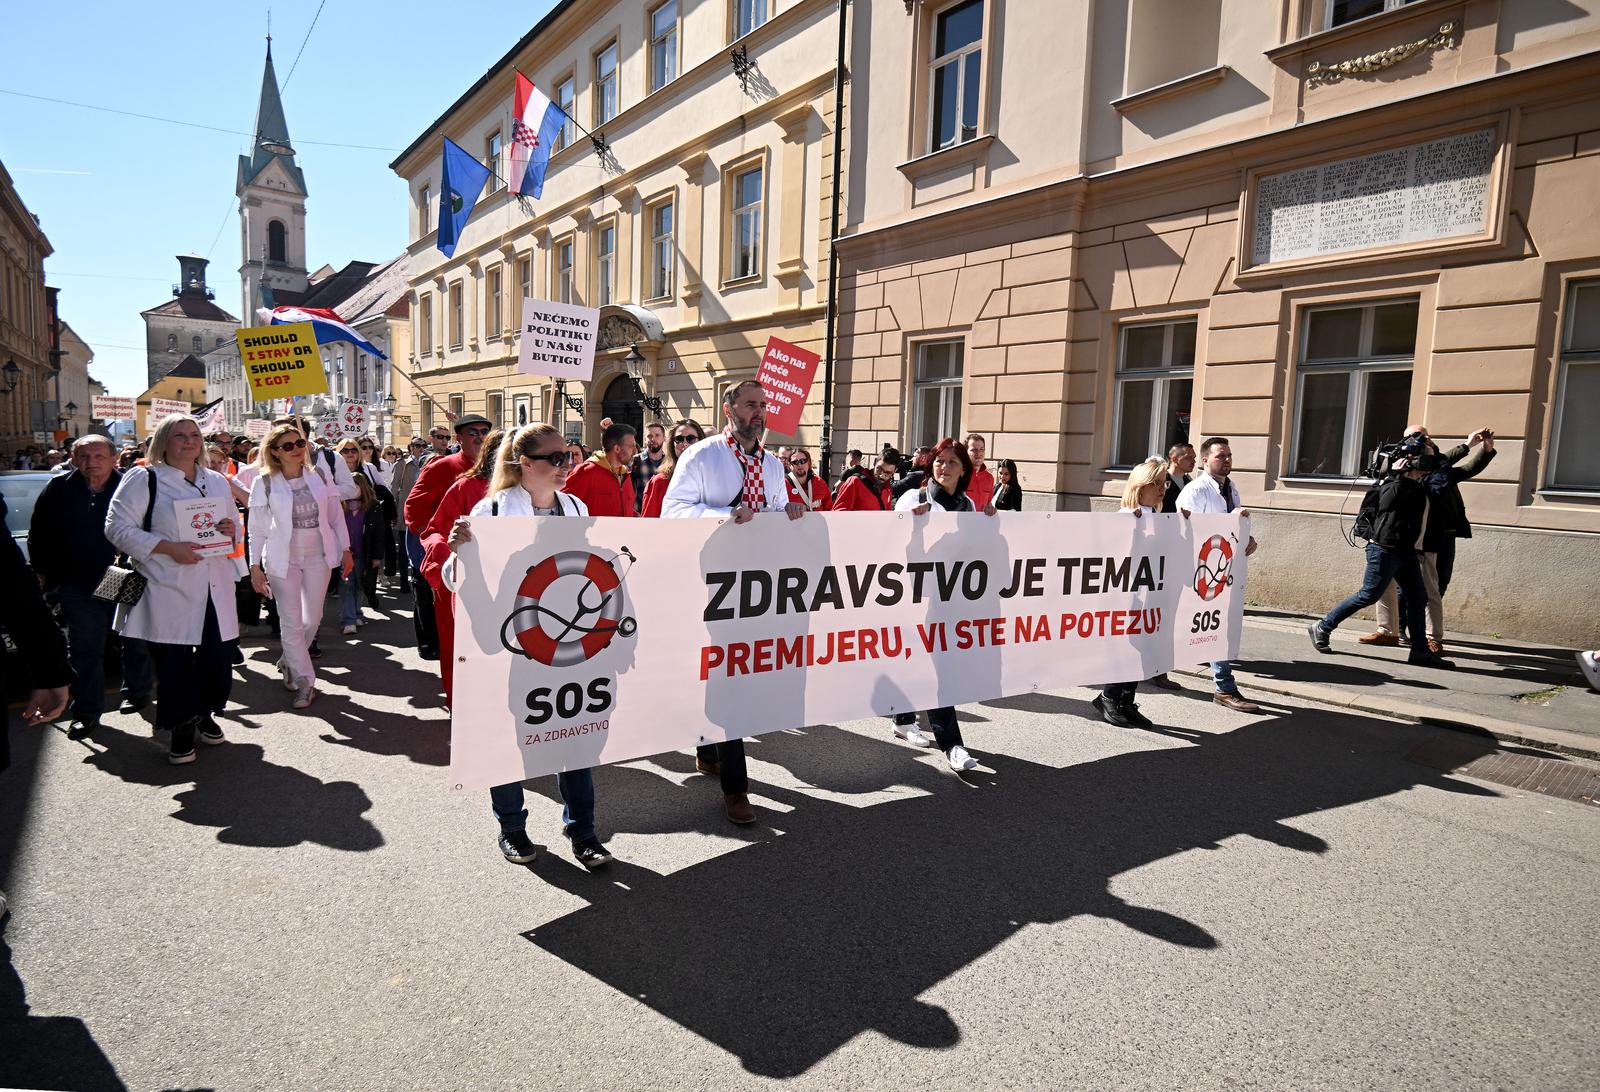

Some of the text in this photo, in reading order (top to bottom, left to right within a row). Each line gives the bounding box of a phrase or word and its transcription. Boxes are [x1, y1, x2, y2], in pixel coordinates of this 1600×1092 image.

[1320, 199, 1363, 210] PRIJEDLOG
[532, 312, 590, 328] NEĆEMO
[527, 324, 592, 341] POLITIKU
[244, 334, 298, 347] SHOULD
[534, 339, 582, 353] U NAŠU
[247, 345, 312, 360] I STAY OR
[532, 352, 582, 366] BUTIGU
[768, 348, 807, 370] Ako nas
[251, 360, 305, 374] SHOULD
[764, 361, 789, 377] neće
[254, 375, 290, 387] I GO?
[760, 372, 806, 398] Hrvatska,
[776, 392, 792, 405] tko
[197, 530, 215, 539] SOS
[703, 556, 1165, 622] ZDRAVSTVO JE TEMA!
[1190, 610, 1221, 634] SOS
[700, 607, 1162, 681] PREMIJERU, VI STE NA POTEZU!
[1196, 635, 1218, 644] ZDRAVSTVO
[524, 677, 612, 725] SOS
[525, 719, 609, 745] ZA ZDRAVSTVO
